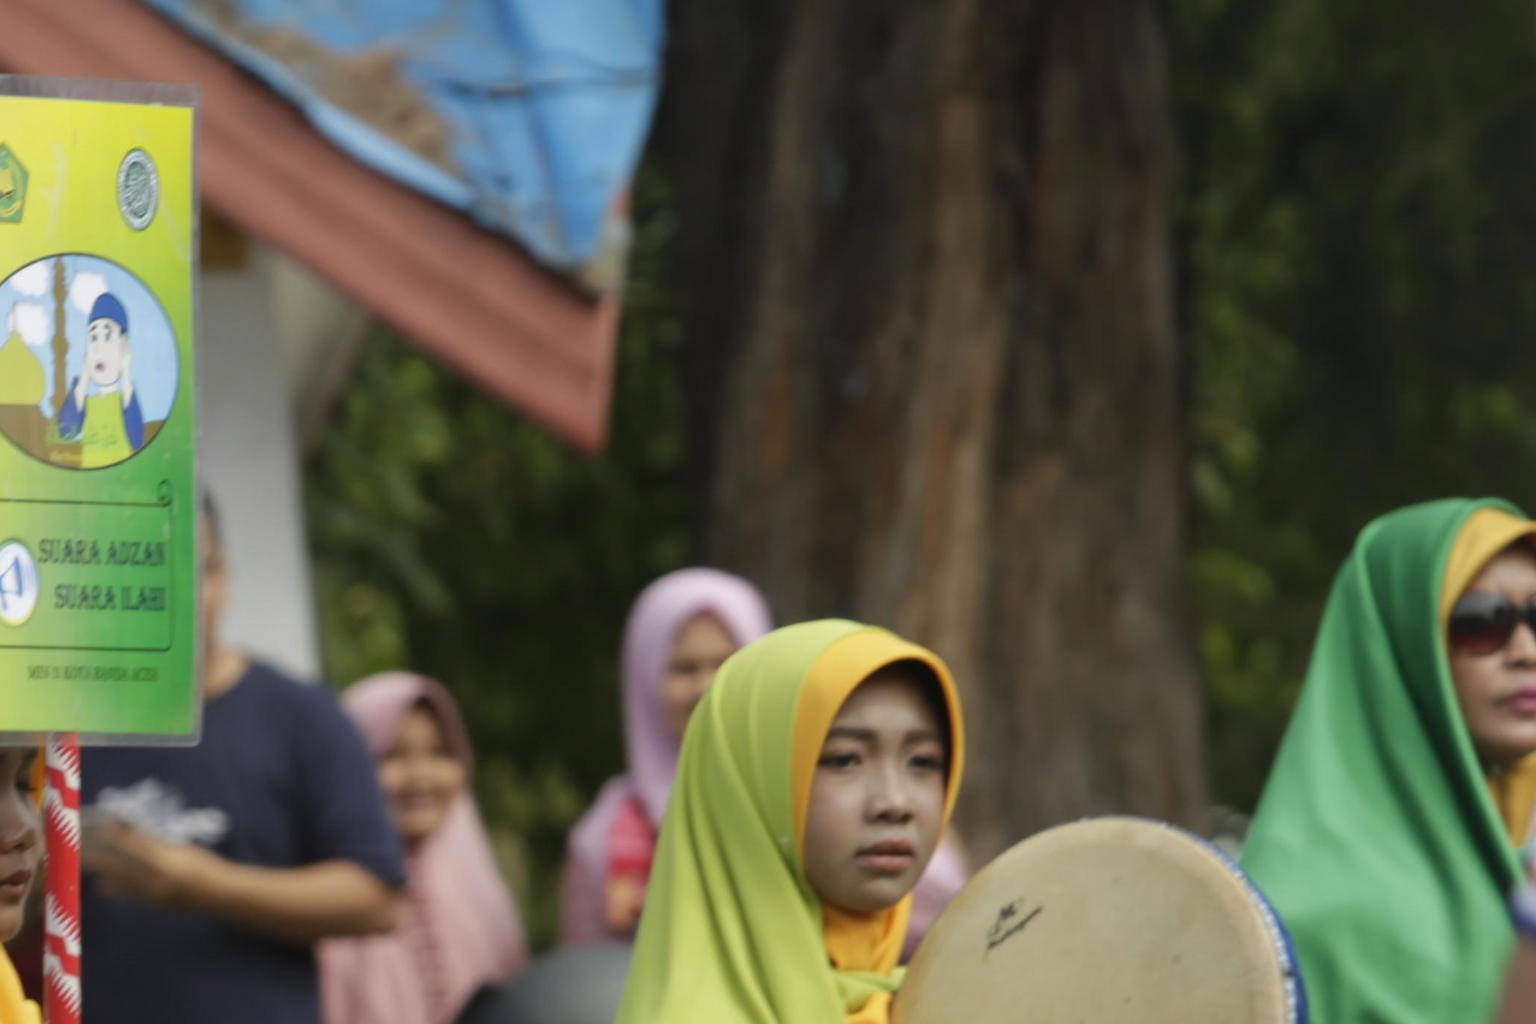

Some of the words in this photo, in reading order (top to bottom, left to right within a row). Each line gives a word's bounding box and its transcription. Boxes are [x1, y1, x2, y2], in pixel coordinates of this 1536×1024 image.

[38, 539, 101, 565] SUARA
[105, 541, 166, 566] ADZAN
[54, 584, 116, 610] SUARA
